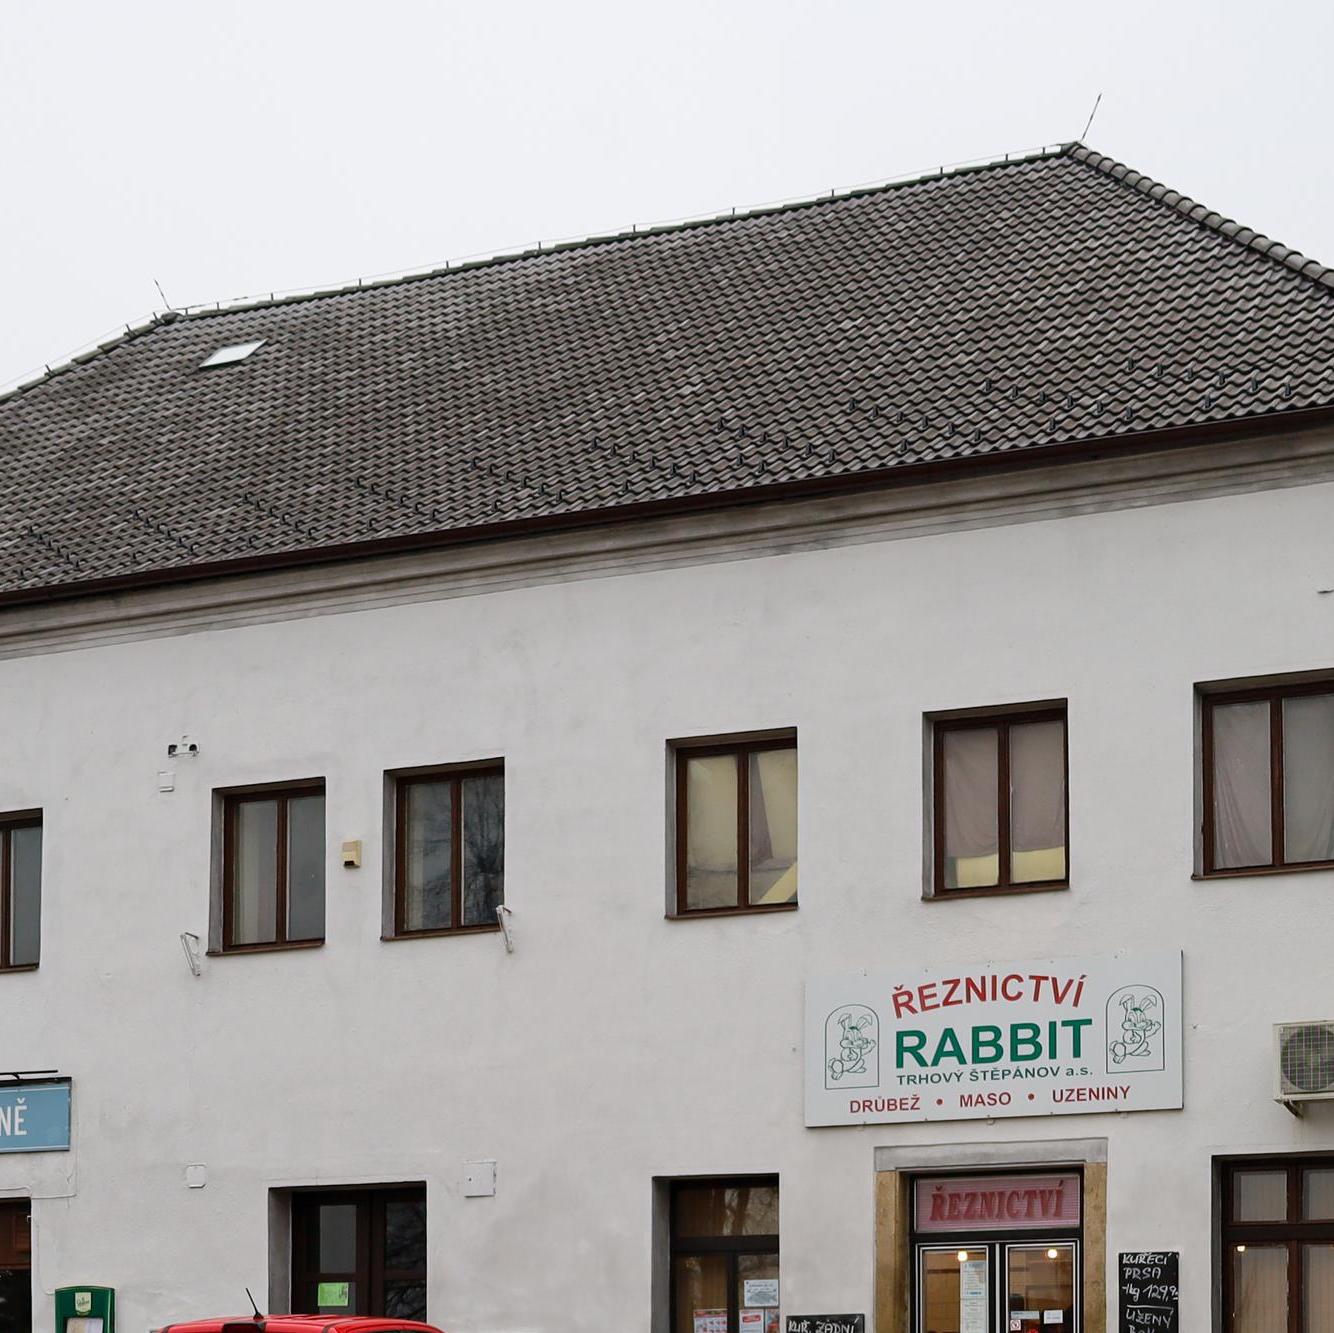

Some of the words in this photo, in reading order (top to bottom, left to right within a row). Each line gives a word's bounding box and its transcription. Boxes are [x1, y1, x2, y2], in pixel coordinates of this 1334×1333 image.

[891, 974, 1088, 1019] ŘEZNICTVÍ
[895, 1018, 1093, 1069] RABBIT
[896, 1069, 966, 1087] TRHOVÝ
[969, 1064, 1060, 1083] ŠTĚPÁNOV
[1066, 1065, 1094, 1078] a.s.
[849, 1093, 921, 1114] DRŮBEŽ
[959, 1092, 1012, 1108] MASO
[1052, 1085, 1132, 1103] UZENINY
[929, 1180, 1065, 1221] ŘEZNICTVÍ
[1122, 1252, 1172, 1264] KUŘECÍ
[1123, 1267, 1161, 1280] PRSA
